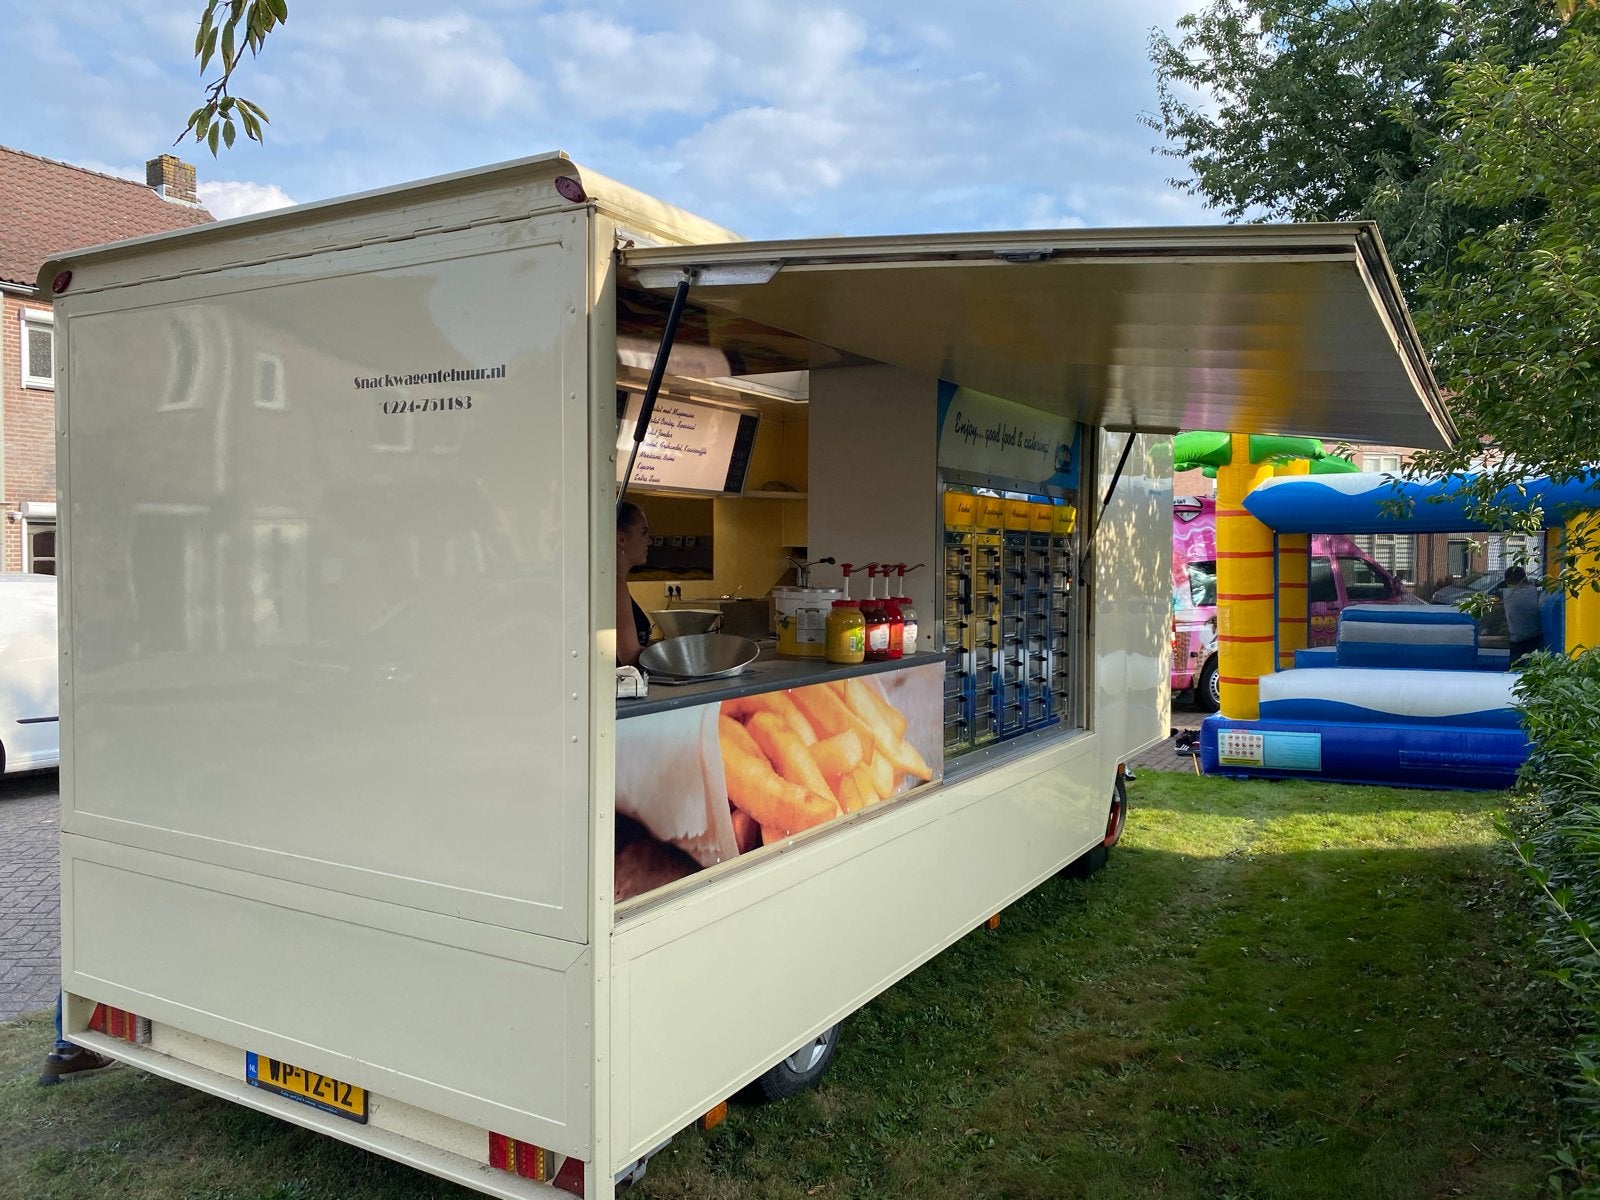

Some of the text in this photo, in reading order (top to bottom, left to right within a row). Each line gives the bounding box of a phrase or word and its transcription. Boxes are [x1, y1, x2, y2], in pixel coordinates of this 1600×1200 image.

[354, 364, 506, 390] Snackwagentehuur.nl
[383, 395, 472, 414] 0224-751183
[985, 422, 1001, 449] good
[1001, 423, 1017, 452] food
[1017, 431, 1024, 448] &
[249, 1064, 257, 1074] NL
